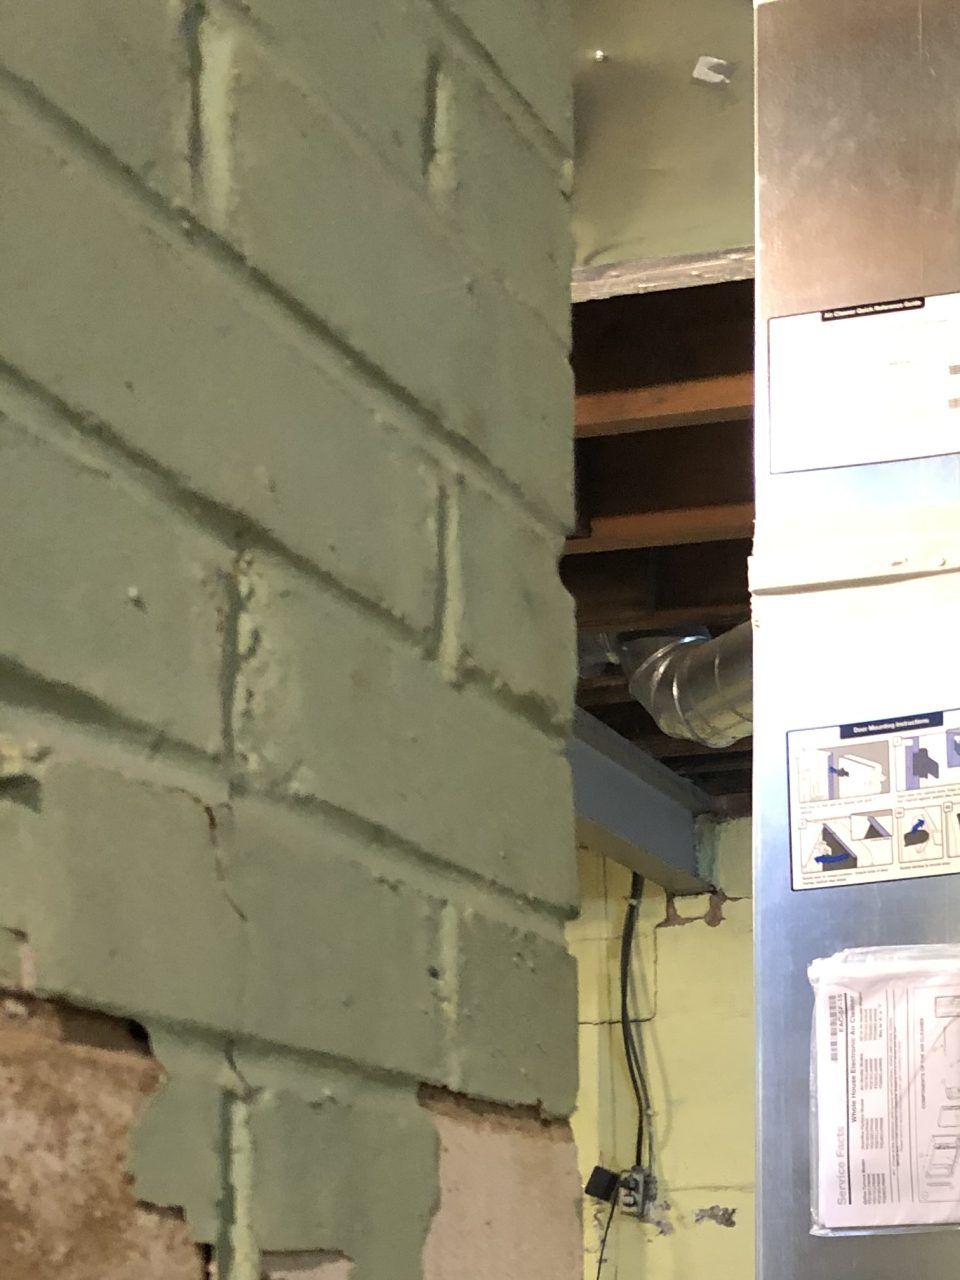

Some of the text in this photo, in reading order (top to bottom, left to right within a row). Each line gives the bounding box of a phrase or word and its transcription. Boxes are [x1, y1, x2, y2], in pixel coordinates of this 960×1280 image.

[874, 303, 903, 311] Reference
[903, 299, 922, 308] Guide
[853, 718, 930, 734] Door Mounting Instructions
[836, 1126, 848, 1206] Service Facts
